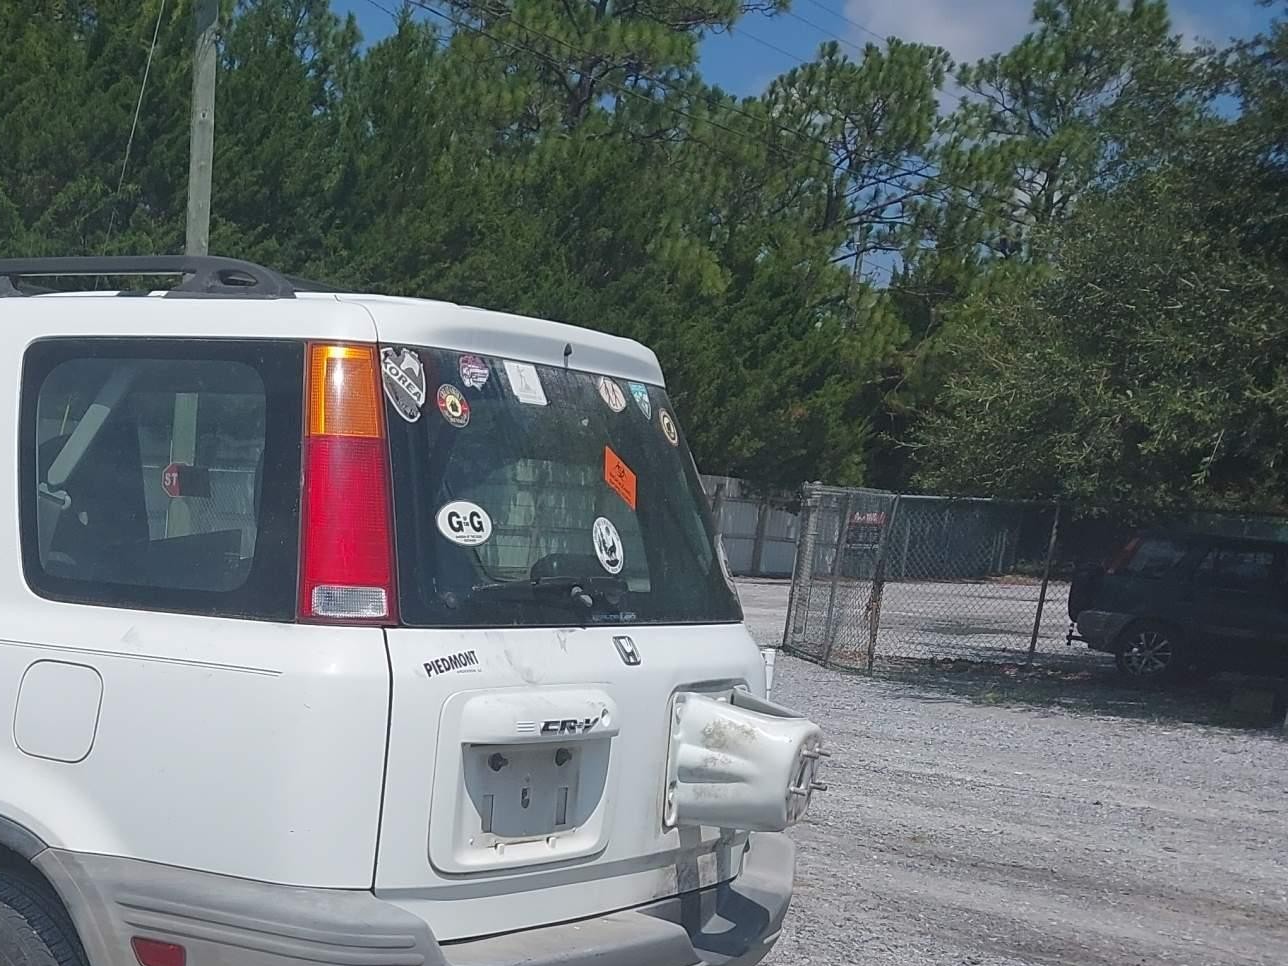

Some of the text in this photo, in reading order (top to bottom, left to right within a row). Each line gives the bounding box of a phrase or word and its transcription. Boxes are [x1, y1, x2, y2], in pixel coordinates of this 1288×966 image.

[383, 358, 422, 402] KOREA
[164, 472, 179, 487] ST
[423, 650, 479, 678] PIEDMONT
[541, 716, 599, 736] CR-V
